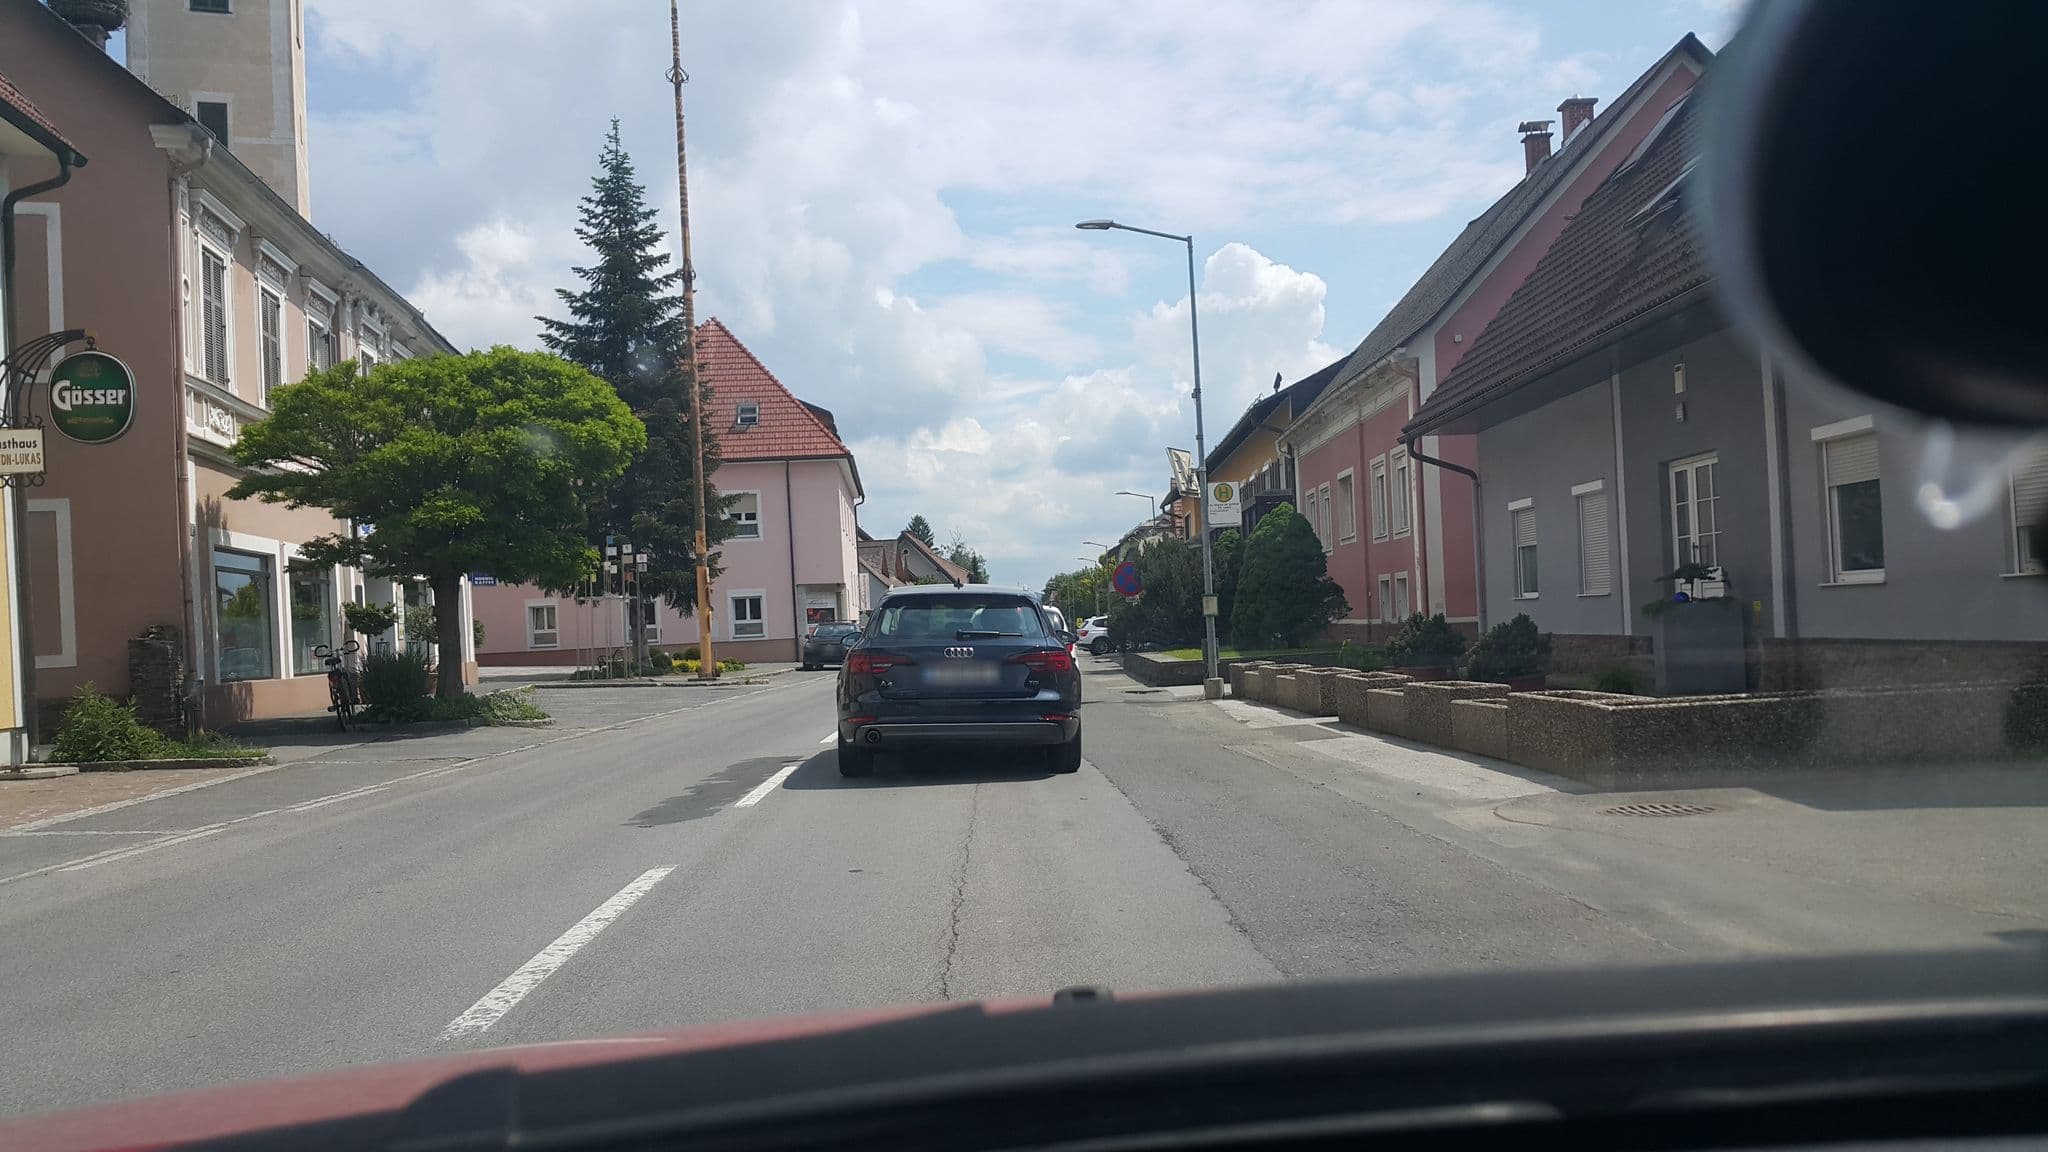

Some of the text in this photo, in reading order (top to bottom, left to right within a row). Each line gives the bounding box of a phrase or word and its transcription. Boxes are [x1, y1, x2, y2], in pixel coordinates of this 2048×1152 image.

[52, 380, 126, 411] Gösser
[0, 437, 37, 449] sthaus
[0, 453, 41, 465] DN-LUKAS
[1218, 486, 1229, 499] H
